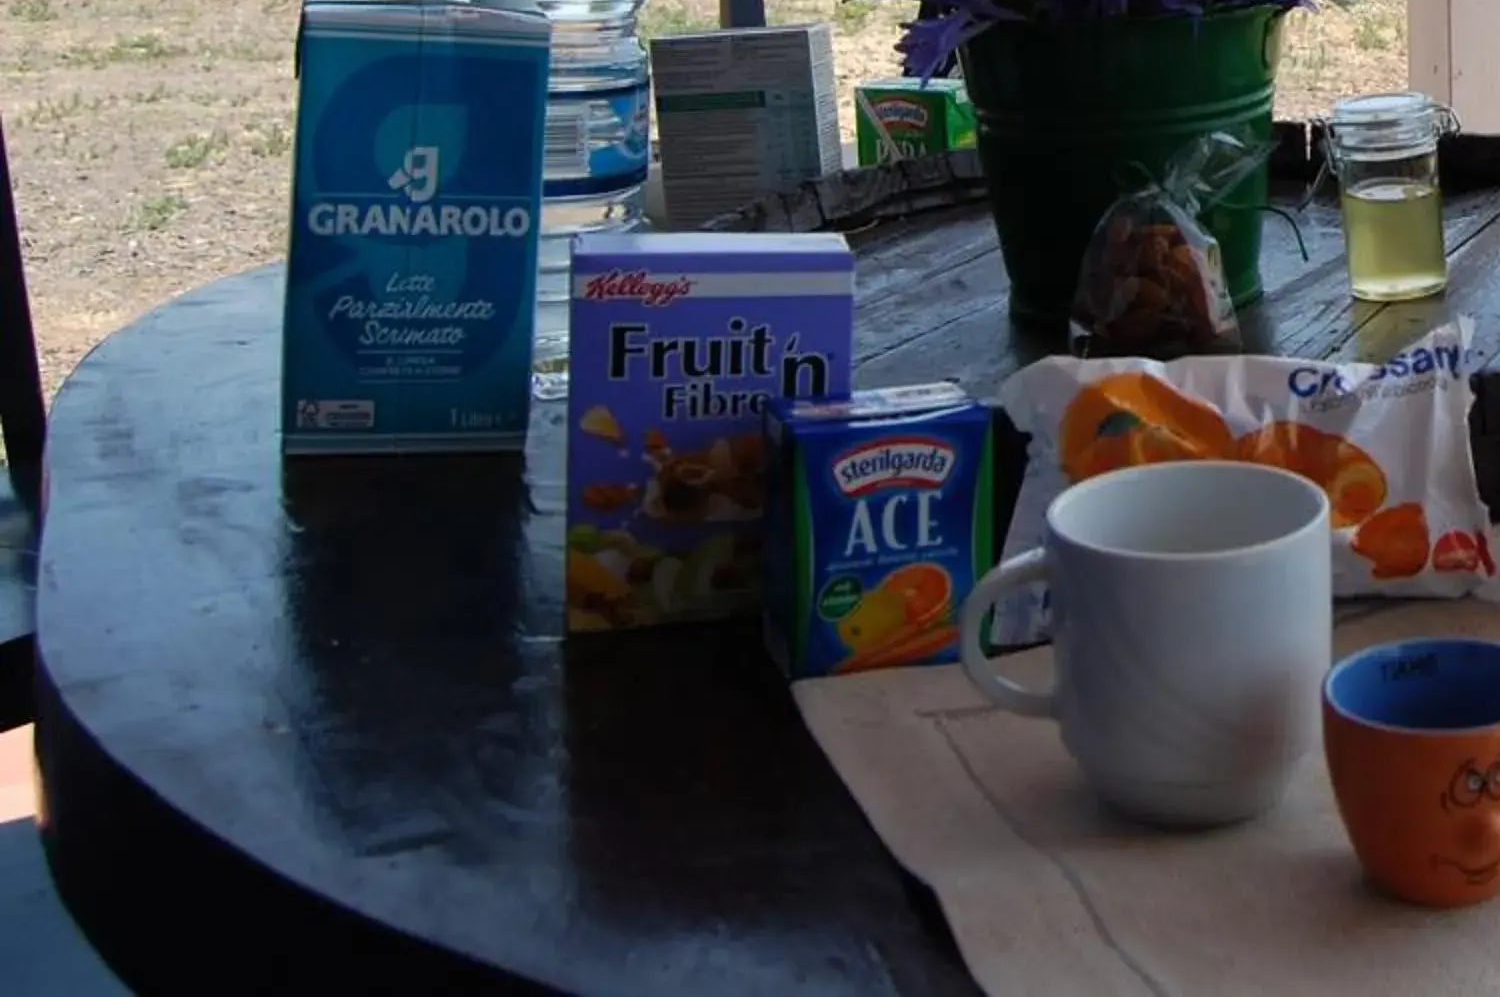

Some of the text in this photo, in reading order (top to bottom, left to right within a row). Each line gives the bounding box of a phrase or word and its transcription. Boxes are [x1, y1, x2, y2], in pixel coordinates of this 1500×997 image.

[307, 203, 531, 237] GRANAROLO
[585, 269, 694, 307] Kellogg's
[609, 316, 776, 380] Fruit
[840, 447, 948, 484] sterilgarda
[843, 489, 945, 557] ACE
